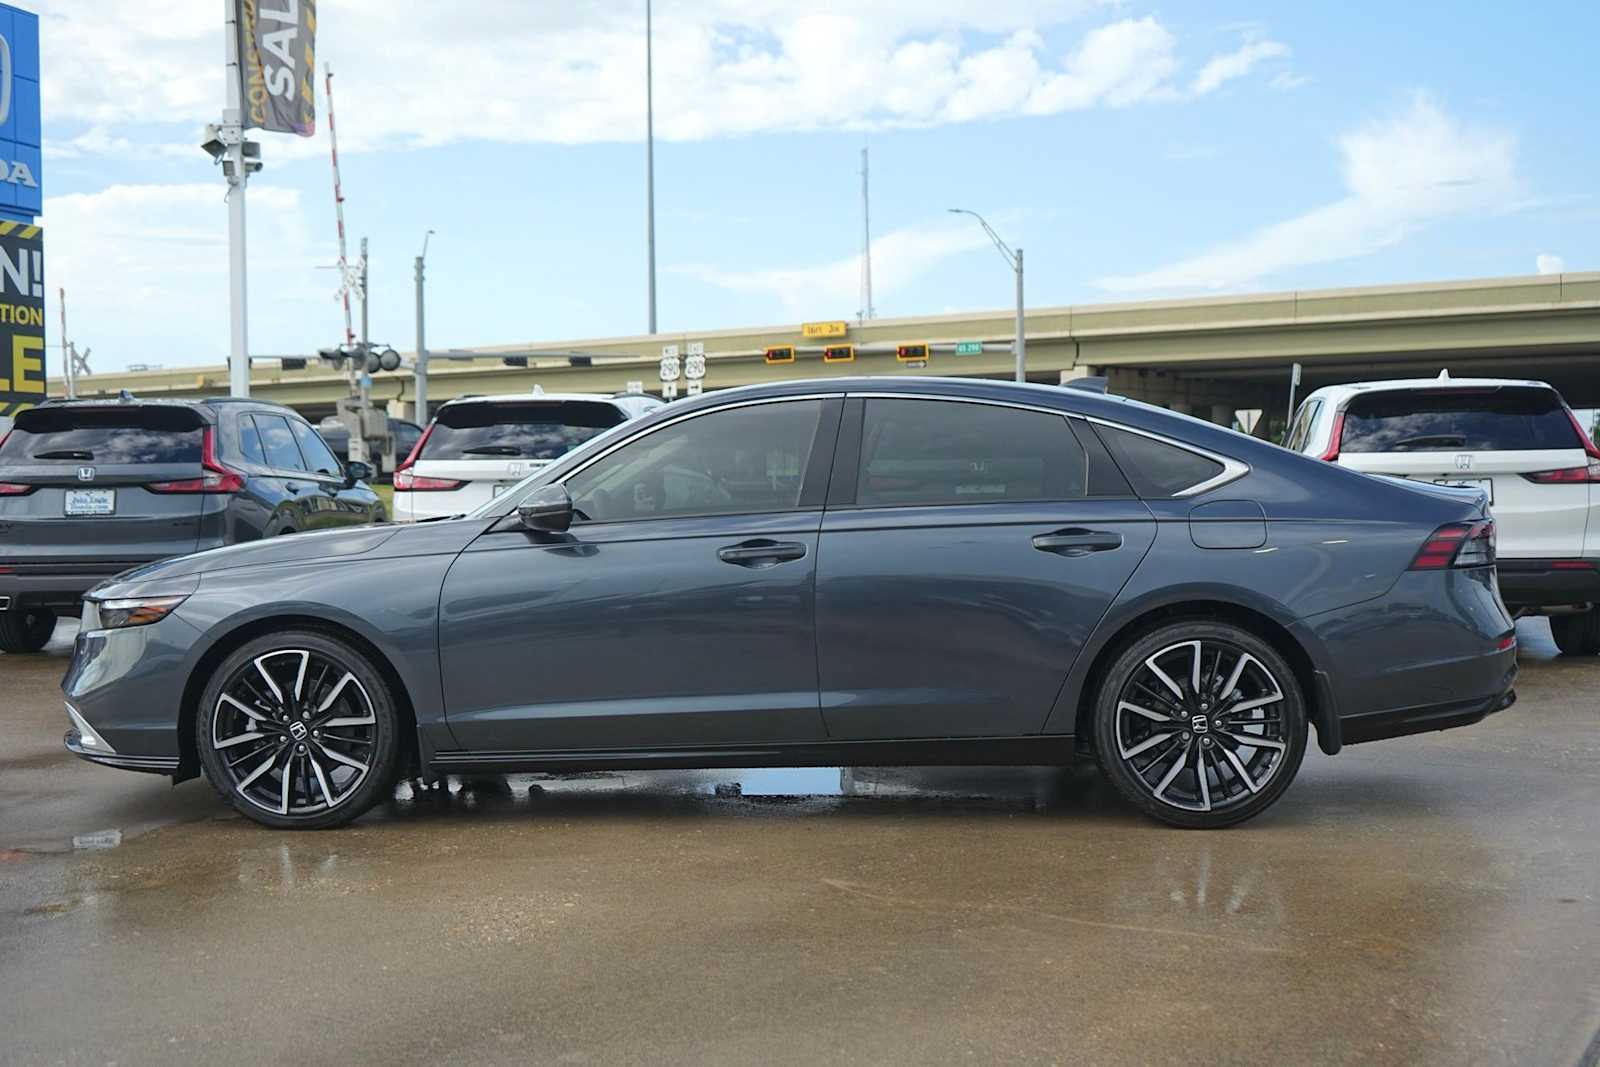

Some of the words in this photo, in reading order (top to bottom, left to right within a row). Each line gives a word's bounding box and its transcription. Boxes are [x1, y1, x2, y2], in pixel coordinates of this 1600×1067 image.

[0, 245, 43, 298] N!
[0, 303, 43, 327] TION
[0, 335, 45, 393] E
[662, 361, 678, 377] 290
[687, 360, 704, 375] 290
